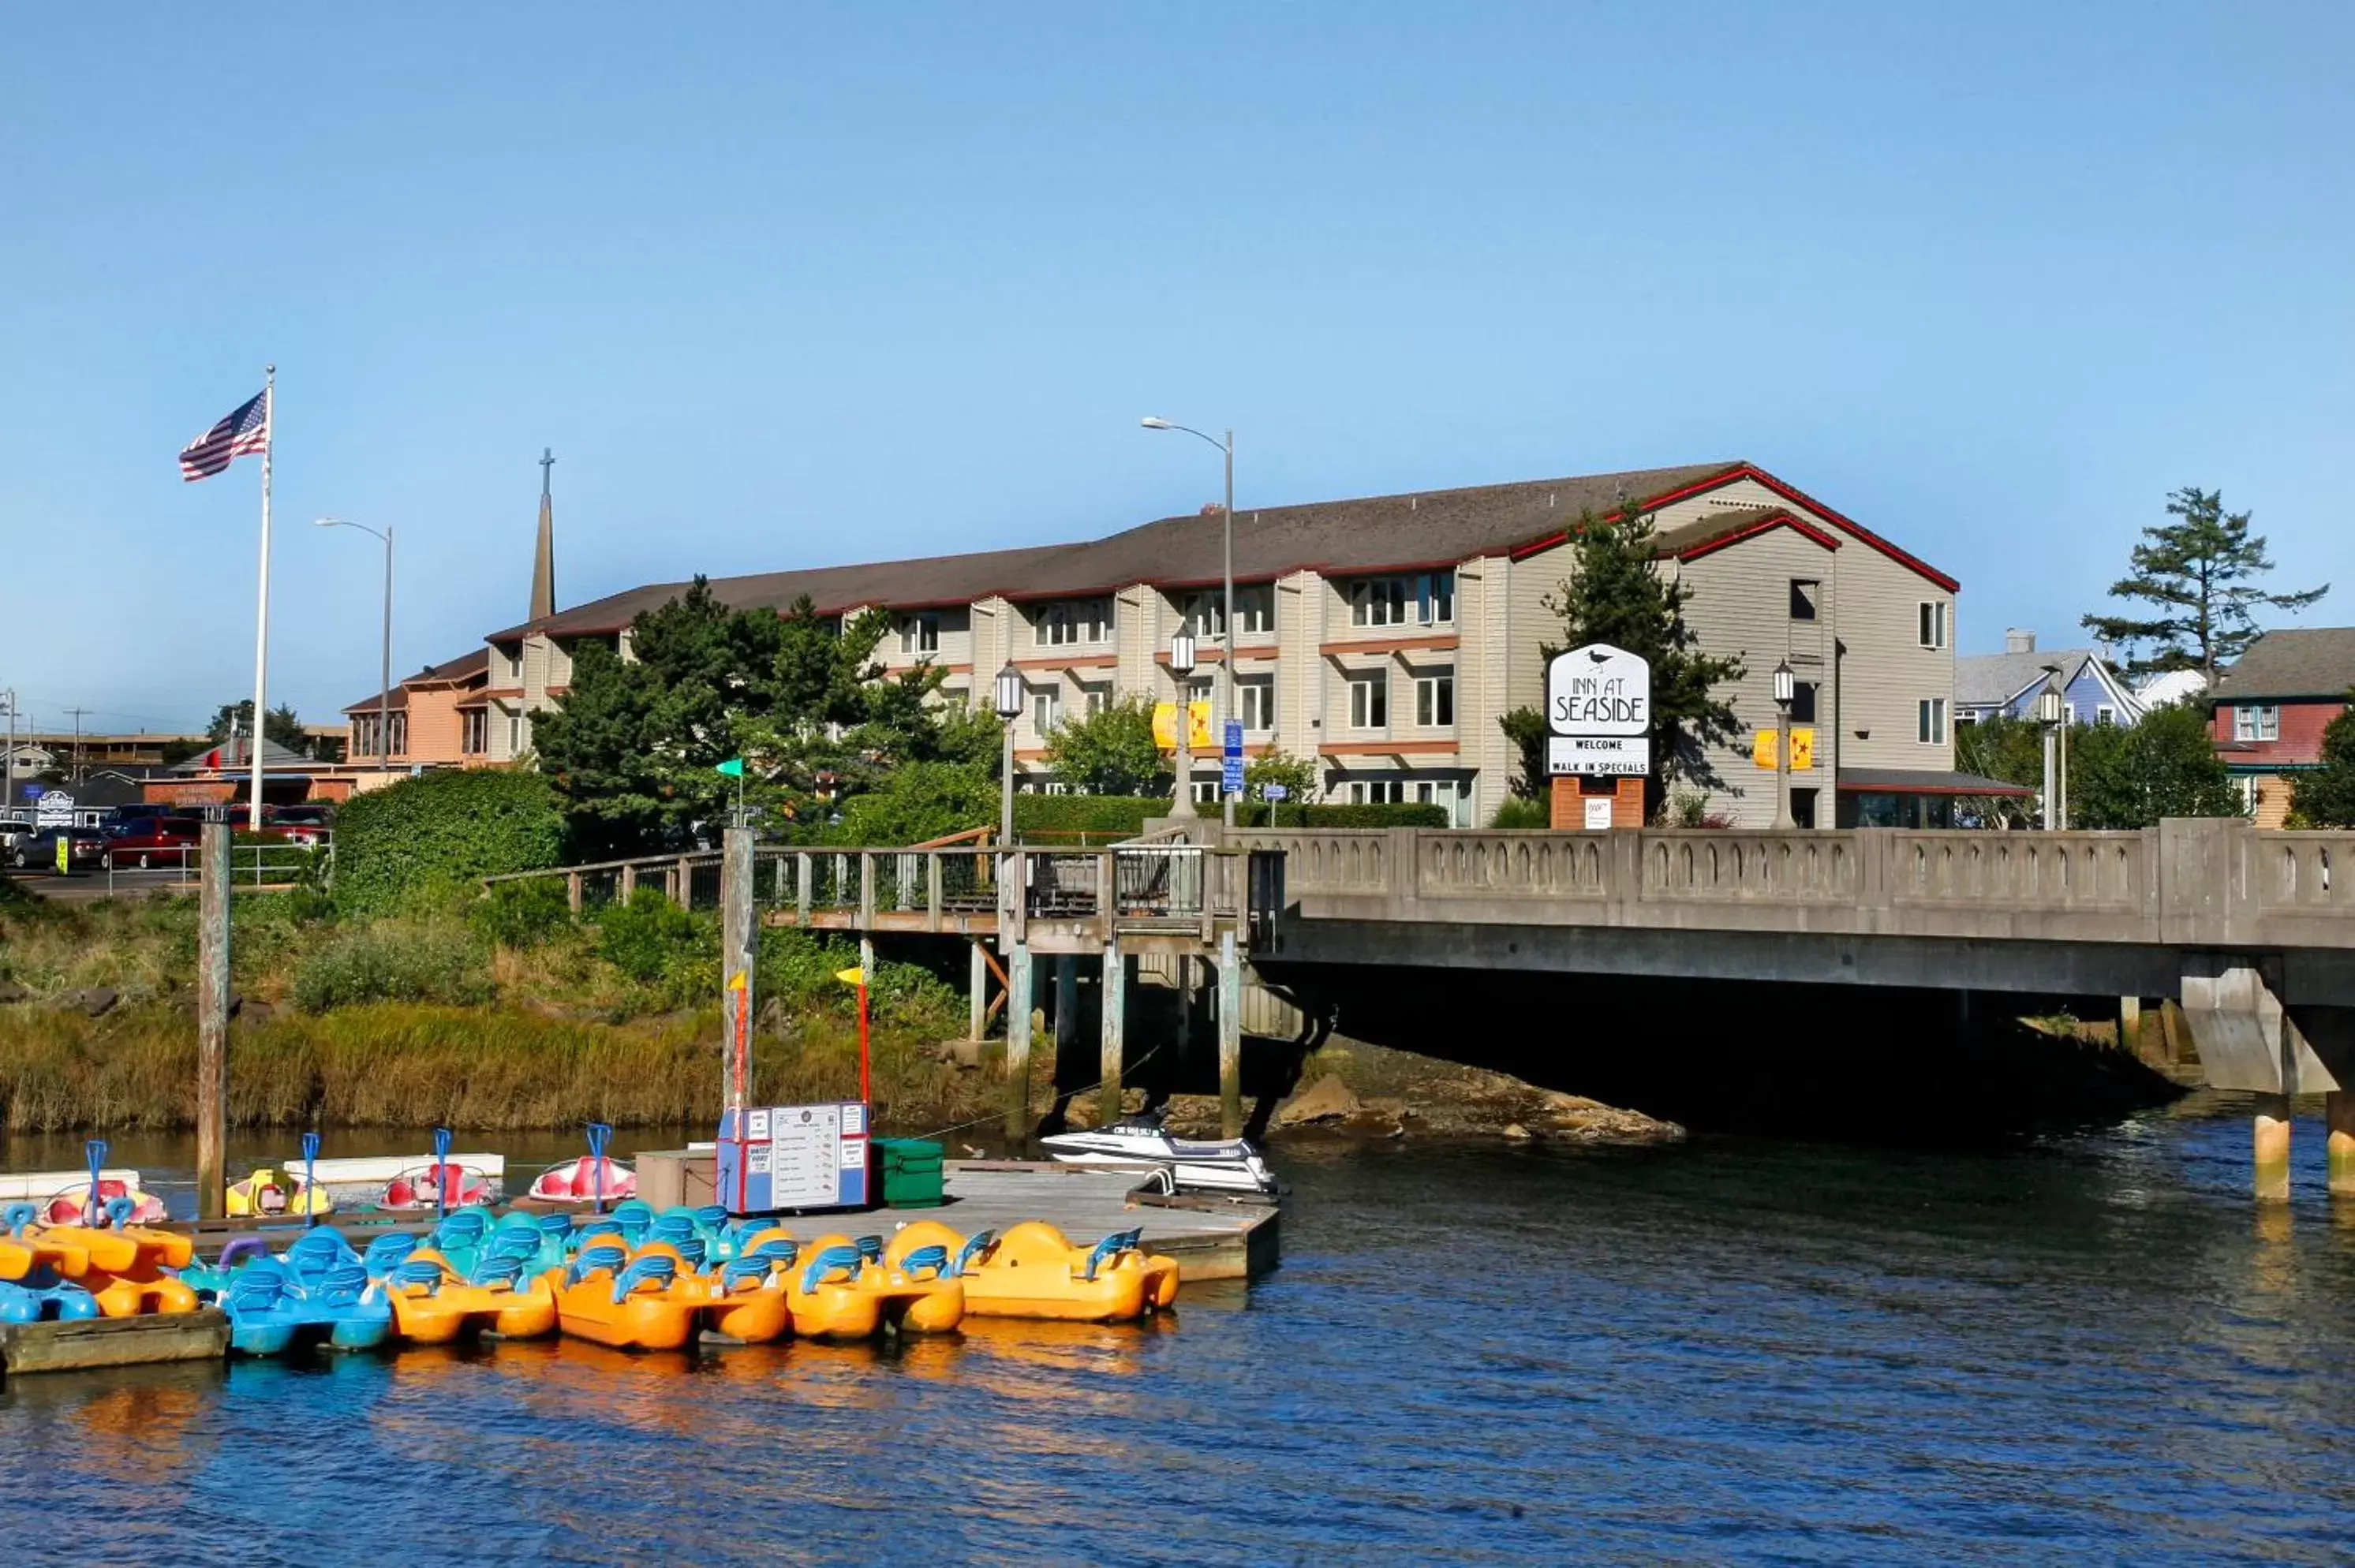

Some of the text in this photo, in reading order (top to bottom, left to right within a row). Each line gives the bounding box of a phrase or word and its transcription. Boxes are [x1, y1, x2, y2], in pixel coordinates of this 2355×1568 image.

[1572, 678, 1625, 695] INN AT
[1554, 696, 1645, 722] SEASIDE
[1576, 741, 1623, 750] WELCOME
[1553, 762, 1647, 773] WALK IN SPECIALS
